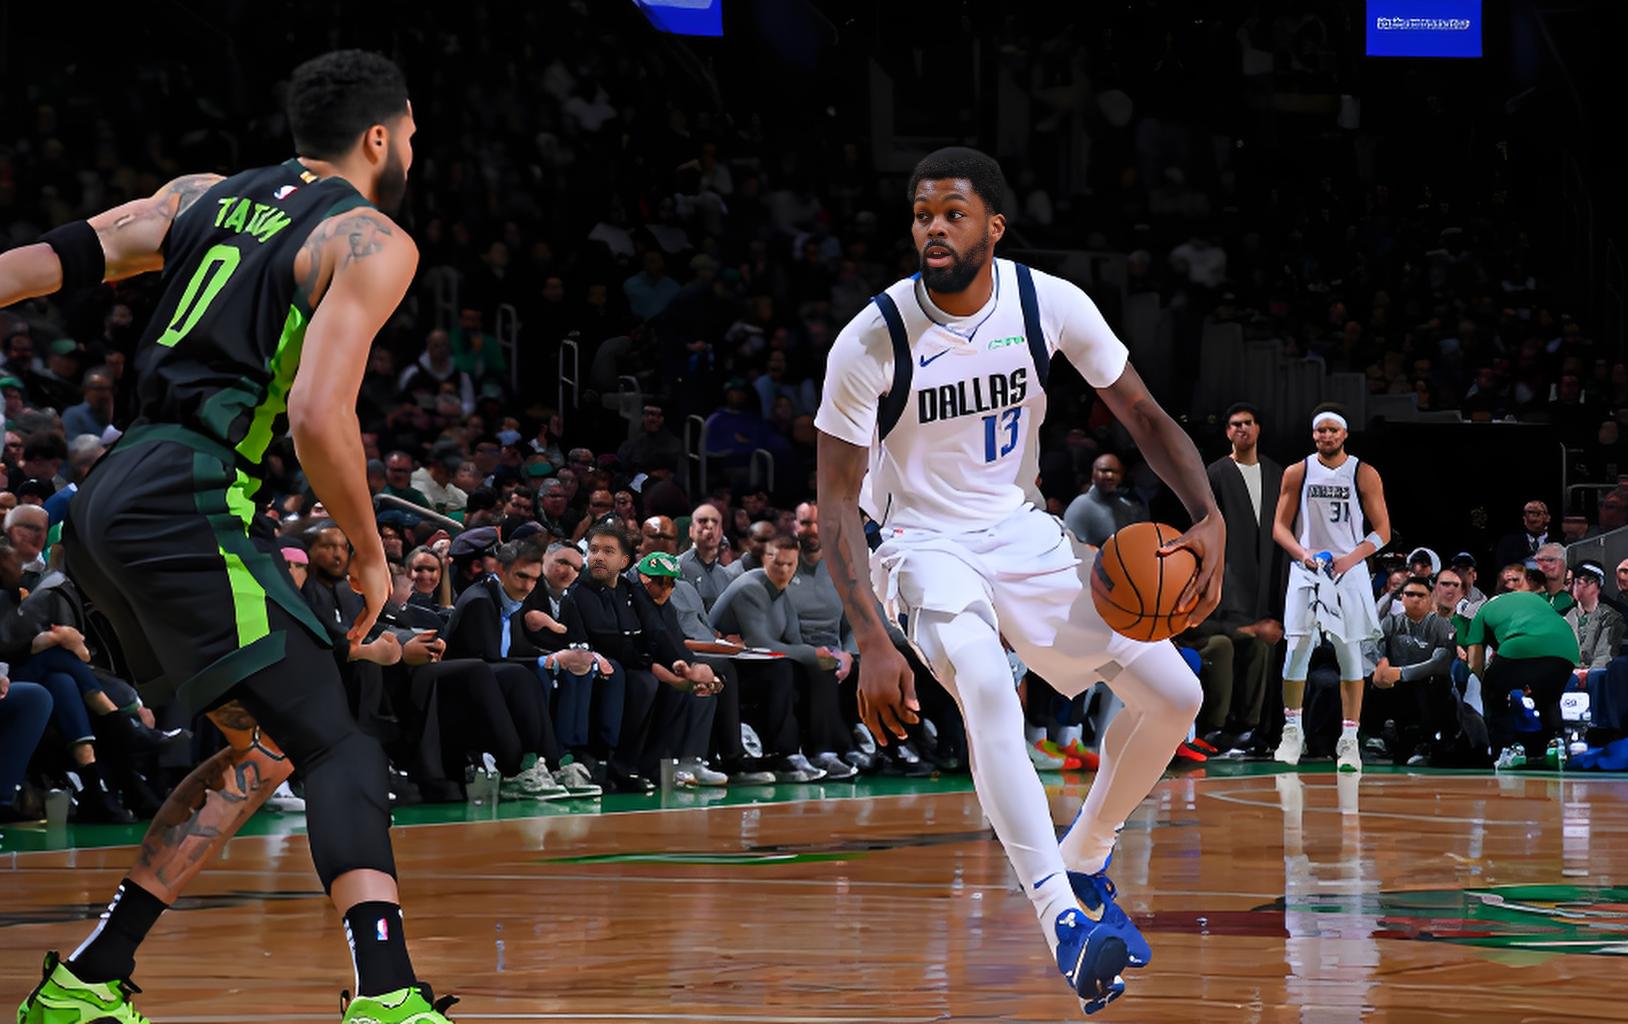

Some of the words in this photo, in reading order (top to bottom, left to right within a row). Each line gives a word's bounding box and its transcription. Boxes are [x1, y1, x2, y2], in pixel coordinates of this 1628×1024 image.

[156, 244, 241, 347] 0
[918, 367, 1027, 424] DALLAS
[981, 406, 1022, 463] 13
[1329, 501, 1350, 523] 31
